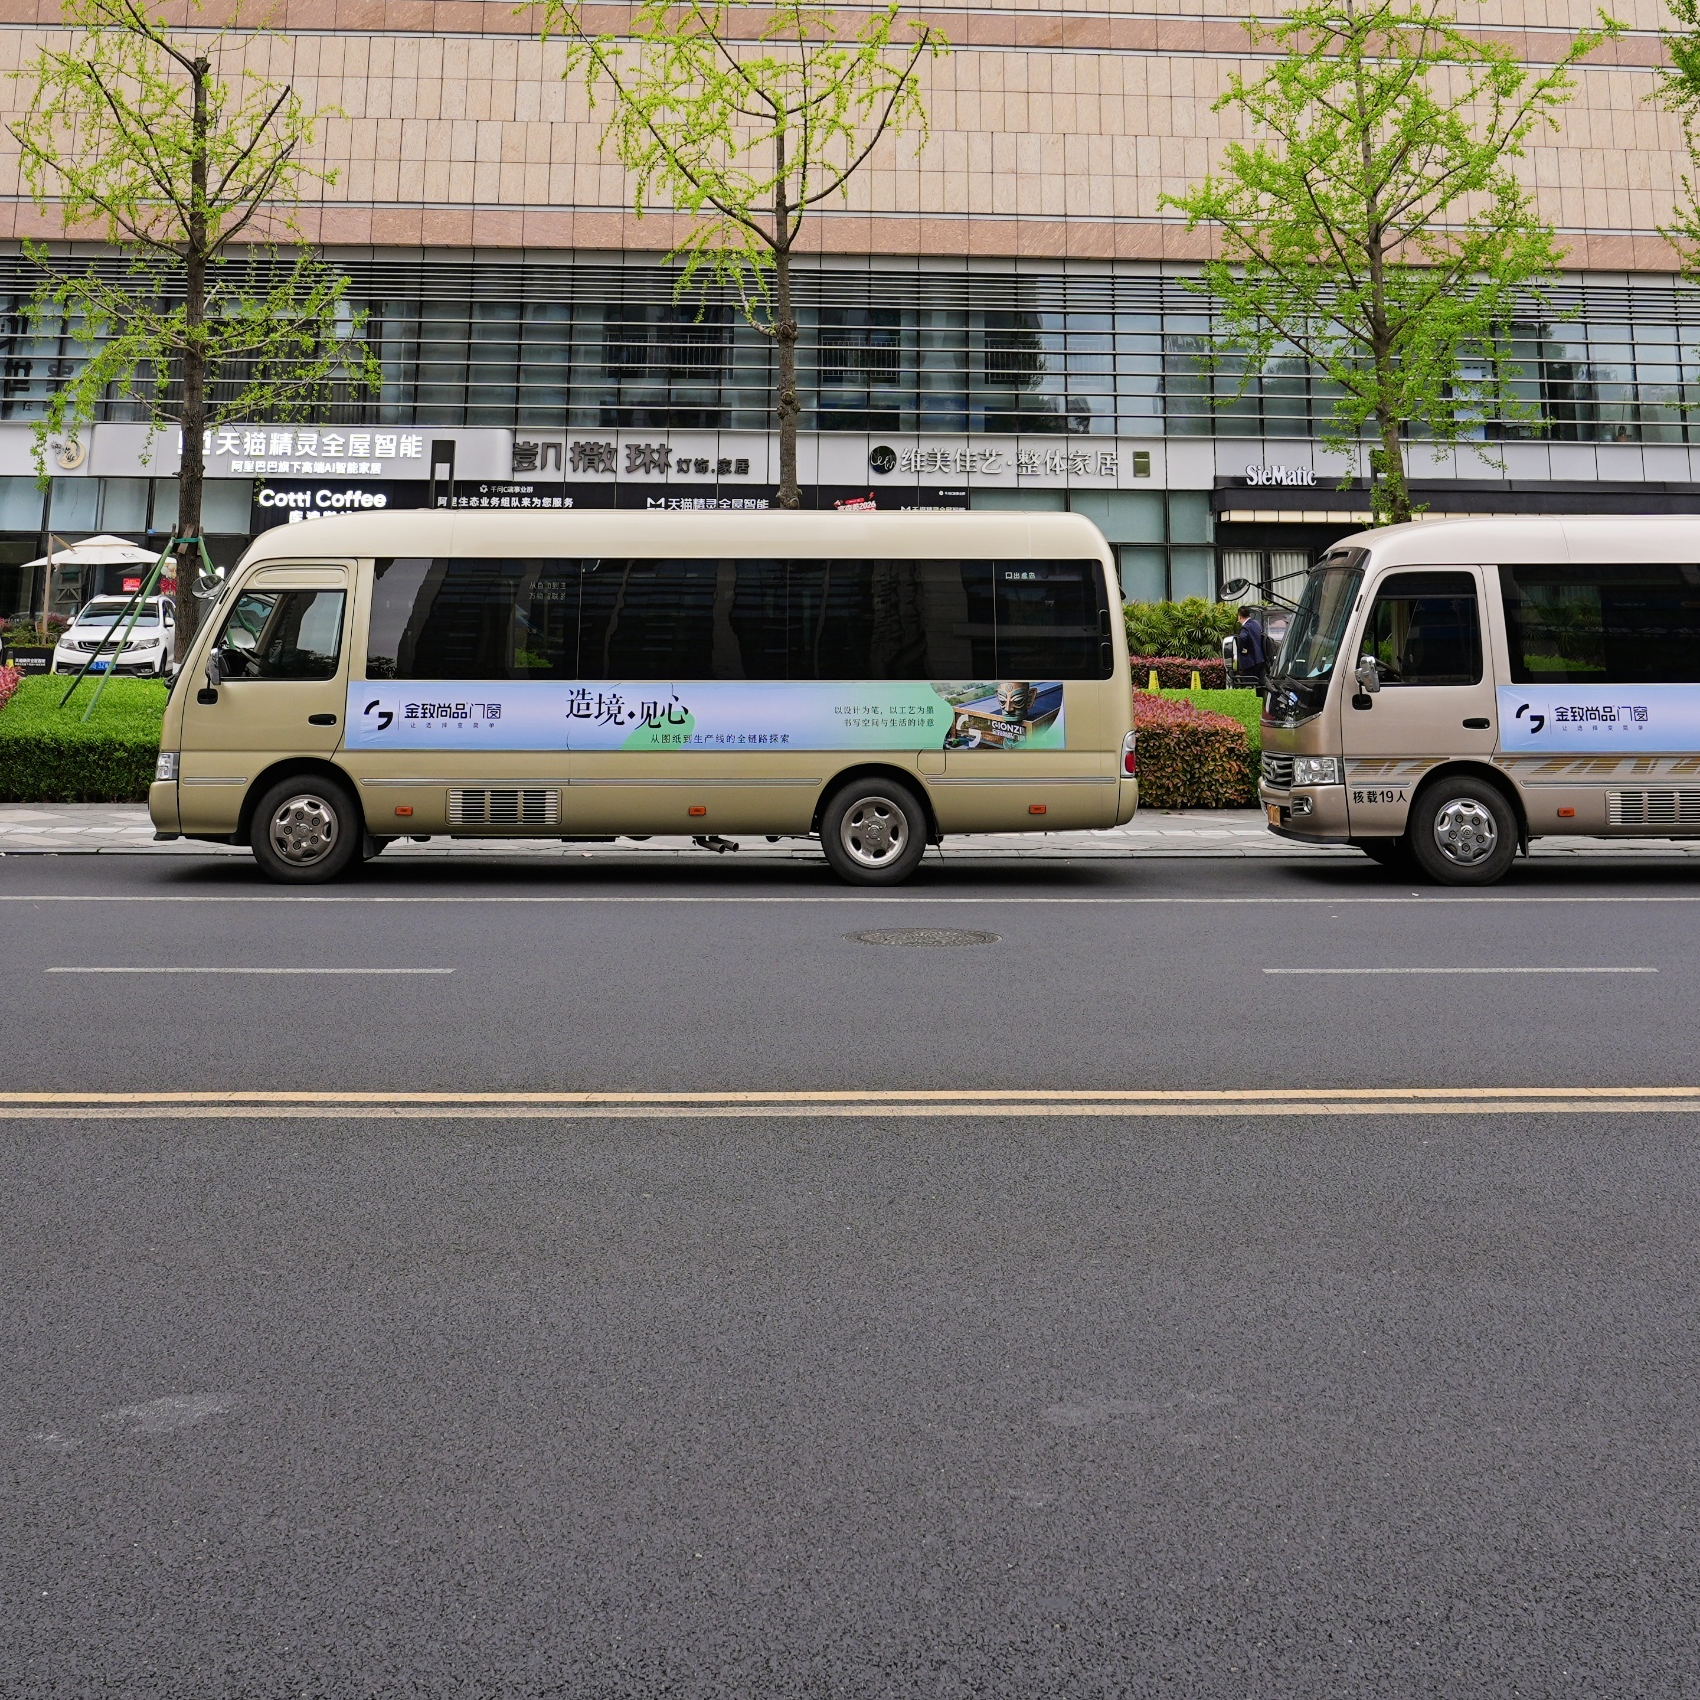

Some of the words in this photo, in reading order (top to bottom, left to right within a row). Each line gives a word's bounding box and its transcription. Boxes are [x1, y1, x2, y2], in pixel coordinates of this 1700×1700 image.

[215, 431, 424, 460] 天猫精灵全屋智能
[231, 460, 383, 476] 阿里巴巴旗下高端AI智能家居
[900, 447, 1120, 477] 维美佳艺·整体家居
[1246, 463, 1318, 487] SieMatic
[258, 489, 313, 509] Cotti
[315, 489, 388, 509] Coffee
[404, 702, 502, 720] 金致尚品门窗
[1554, 705, 1649, 723] 金致尚品门窗
[843, 717, 935, 728] 书写空间与生活的诗意
[650, 733, 790, 745] 从图纸到生产线的全链路探索
[1352, 790, 1408, 804] 核载19人
